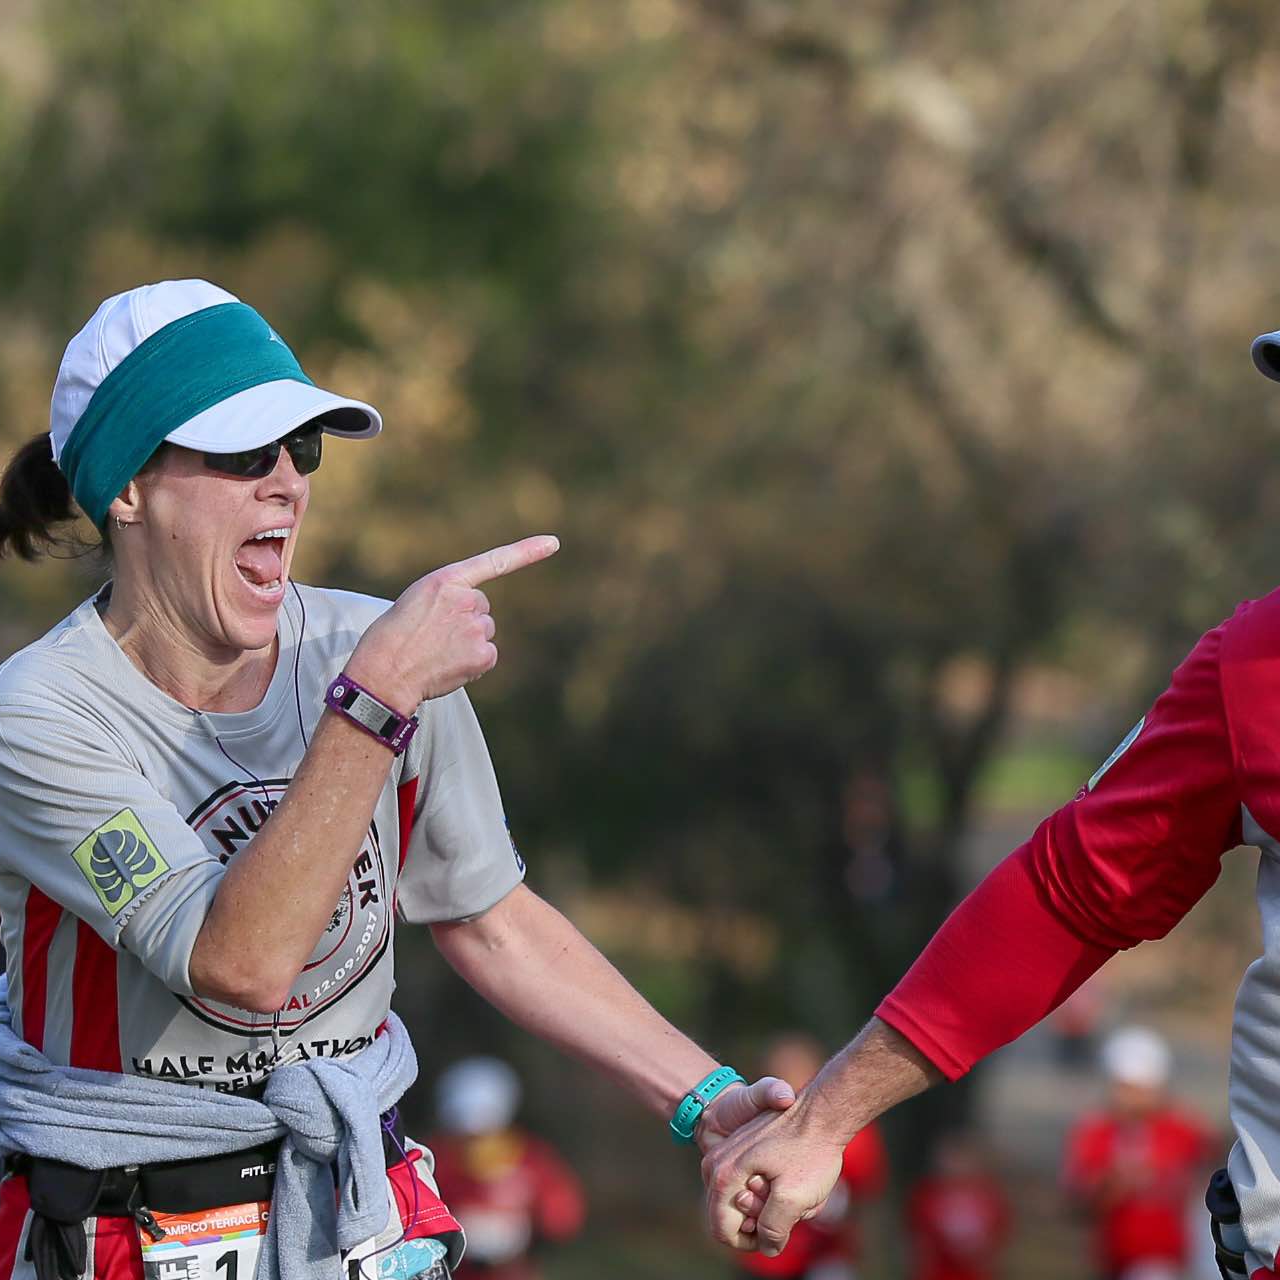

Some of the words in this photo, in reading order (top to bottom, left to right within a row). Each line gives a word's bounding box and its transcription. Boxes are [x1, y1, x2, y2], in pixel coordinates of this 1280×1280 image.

[313, 911, 377, 1000] 12.09.2017
[161, 1222, 208, 1236] AMPICO
[210, 1214, 260, 1230] TERRACE
